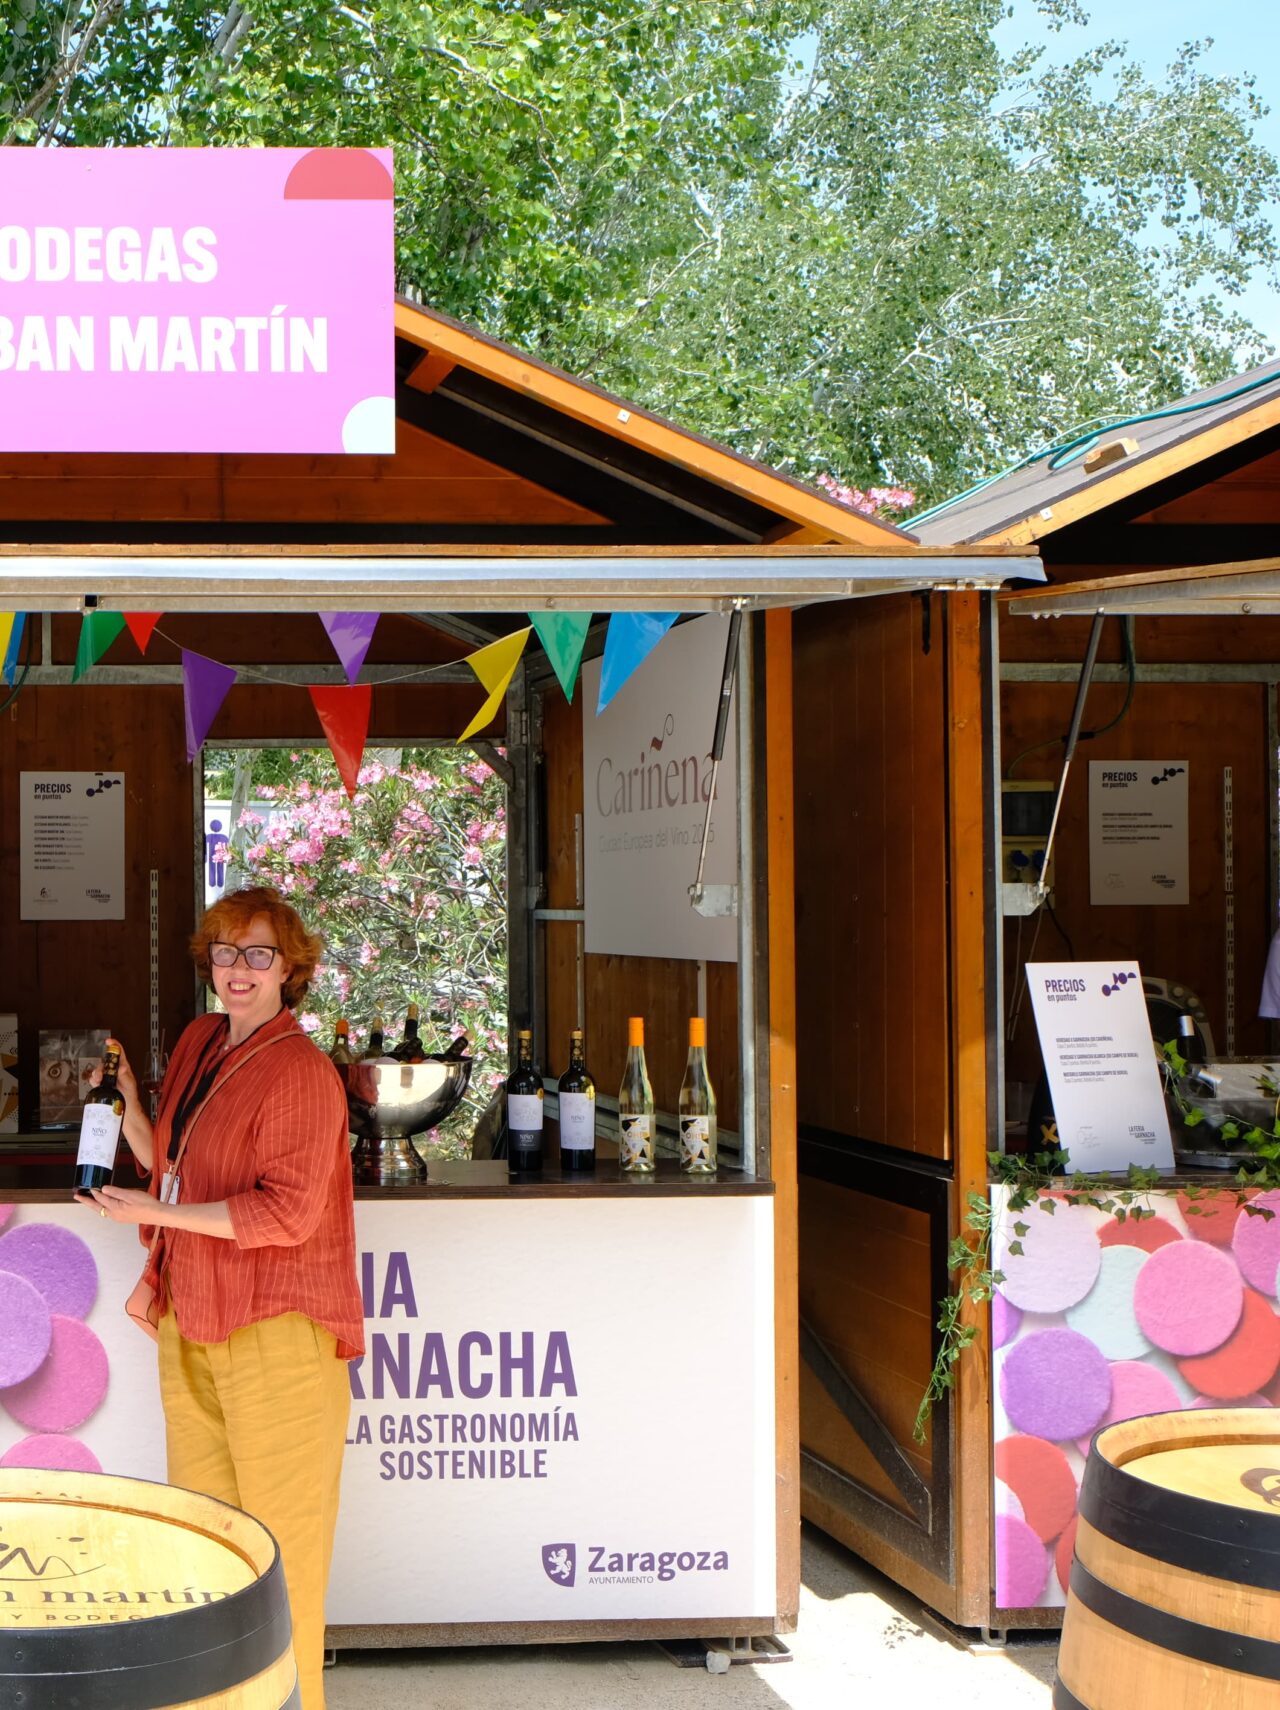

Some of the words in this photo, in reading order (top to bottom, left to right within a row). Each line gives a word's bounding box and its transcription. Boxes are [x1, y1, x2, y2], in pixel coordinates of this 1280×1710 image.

[108, 304, 329, 373] MARTÍN
[1102, 771, 1138, 783] PRECIOS
[34, 783, 72, 794] PRECIOS
[1111, 781, 1129, 789] puntos
[42, 793, 62, 801] puntos
[655, 828, 670, 848] del
[670, 826, 689, 846] Vino
[692, 822, 715, 844] 205
[1044, 978, 1086, 993] PRECIOS
[1047, 994, 1056, 1002] en
[1056, 992, 1077, 1003] puntos
[379, 1406, 580, 1444] GASTRONOMÍA
[379, 1448, 548, 1481] SOSTENIBLE
[588, 1546, 730, 1582] Zaragoza
[588, 1575, 654, 1585] AYUNTAMIENTO
